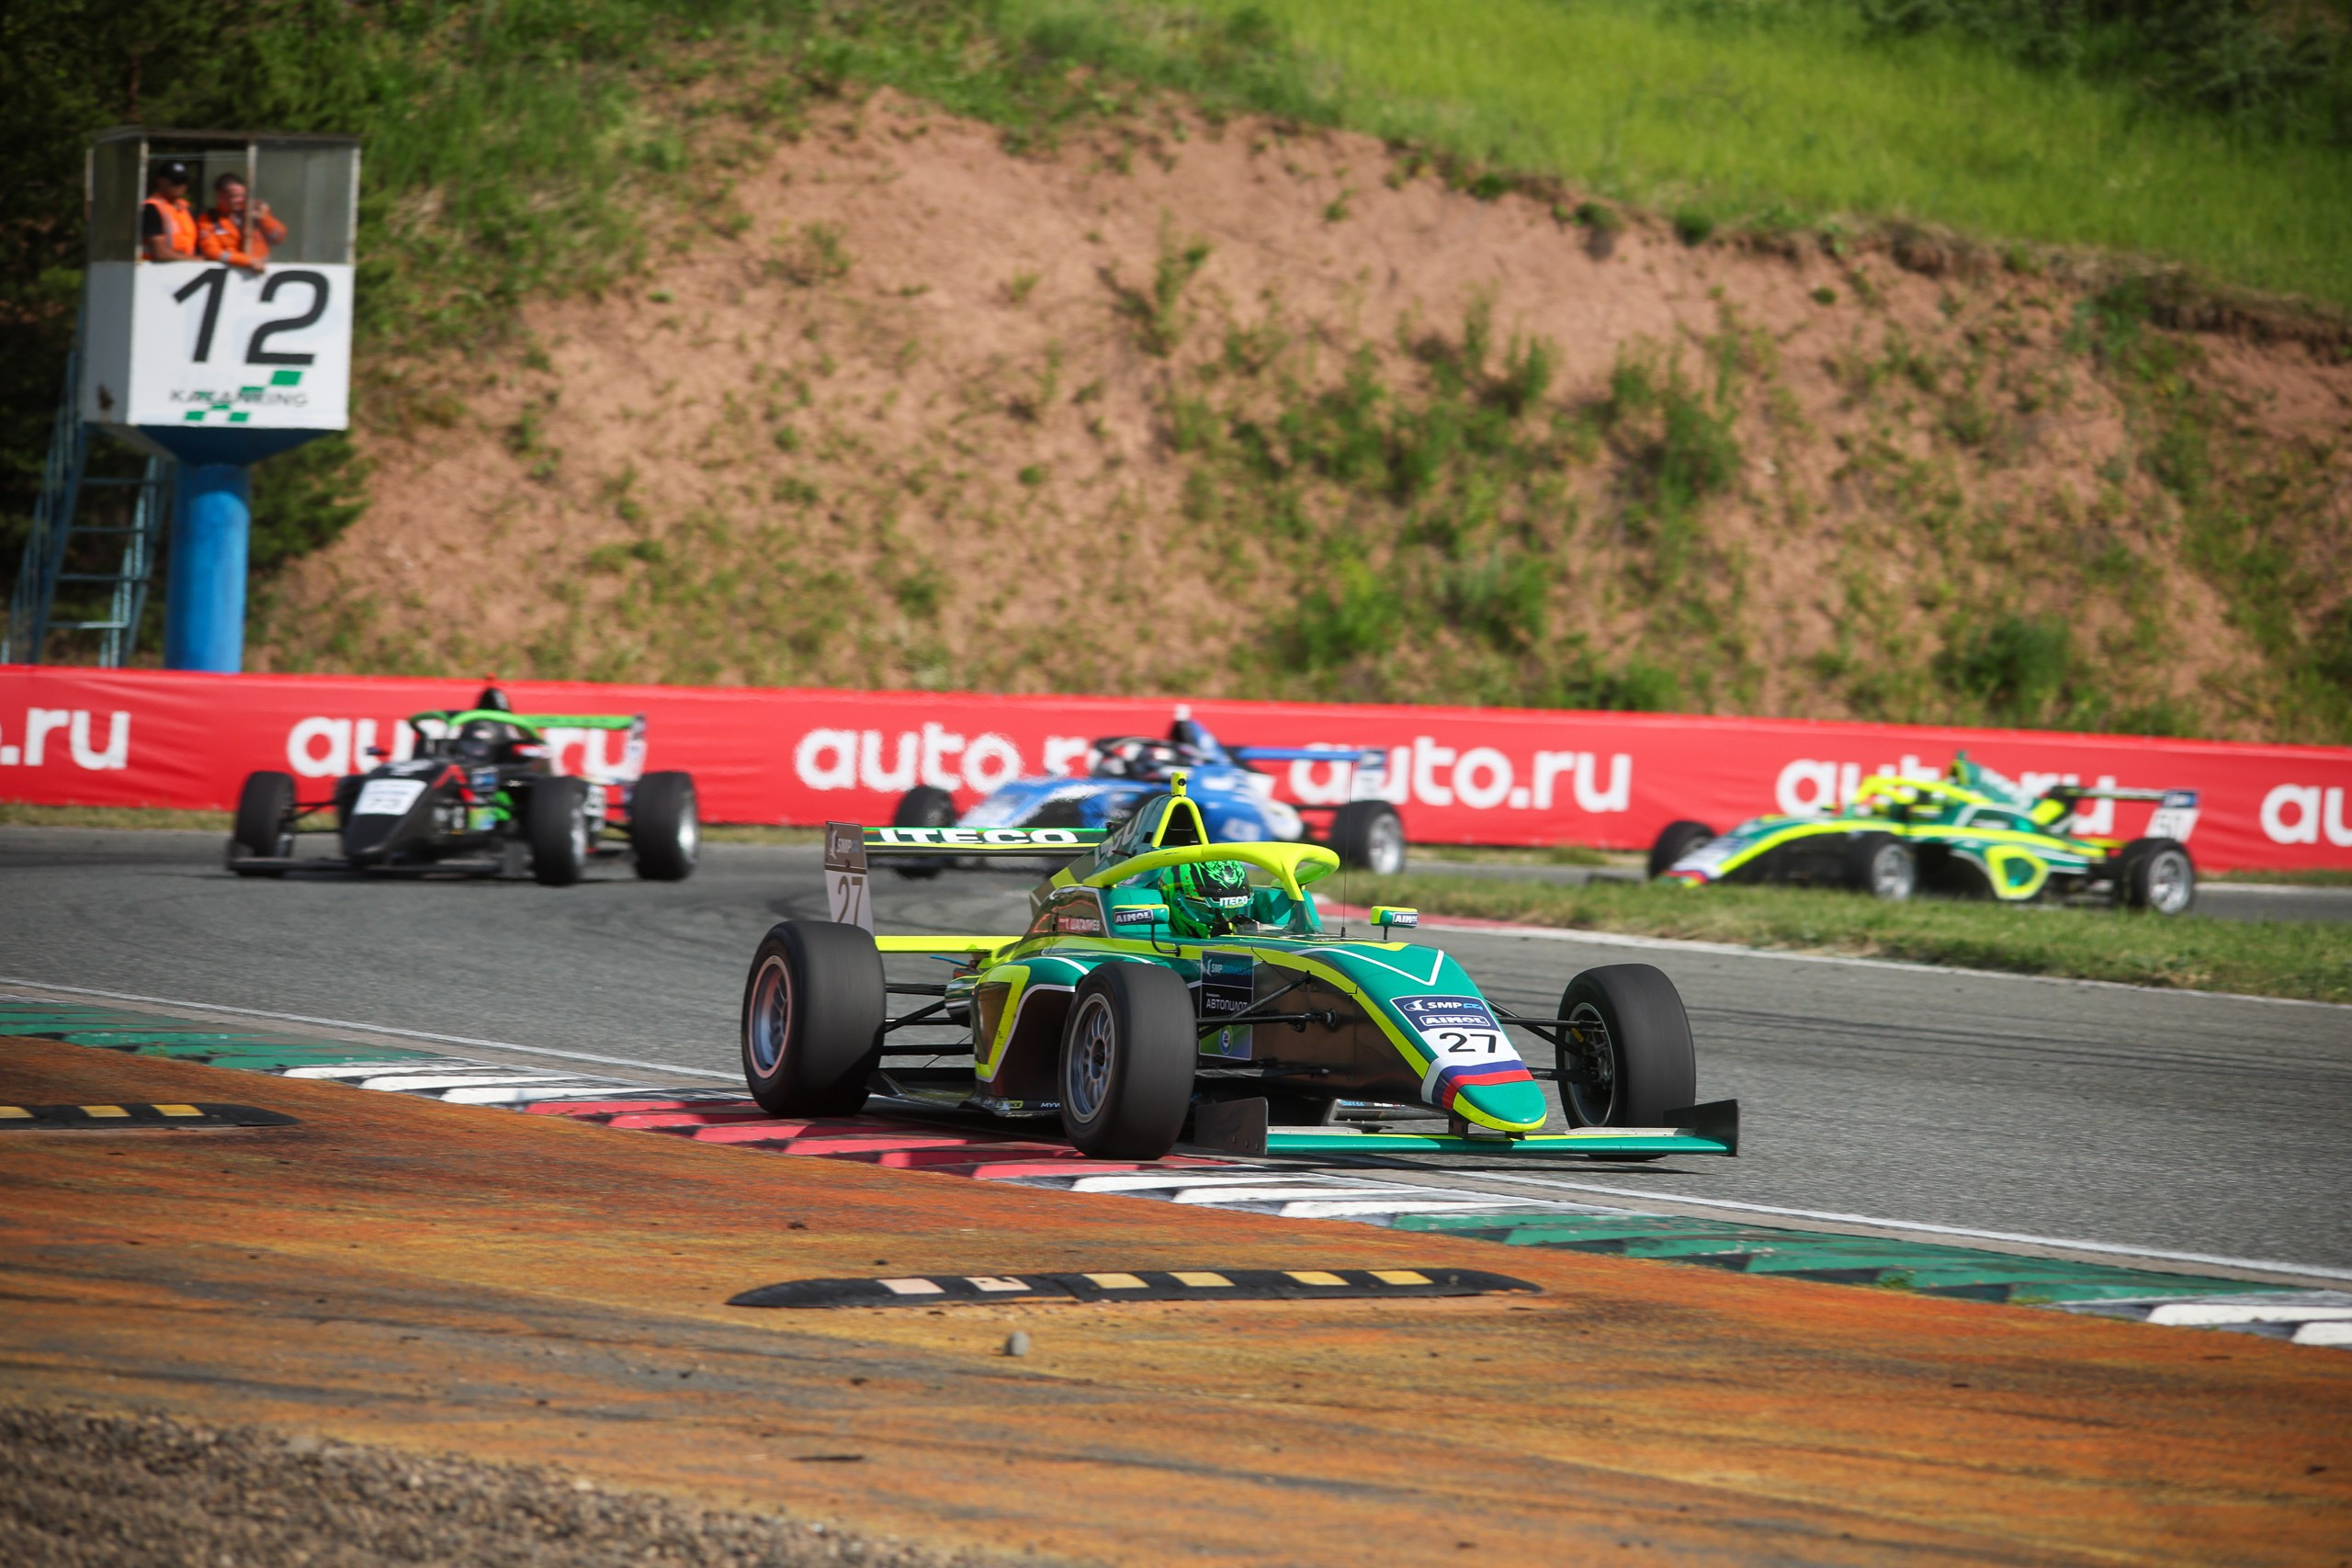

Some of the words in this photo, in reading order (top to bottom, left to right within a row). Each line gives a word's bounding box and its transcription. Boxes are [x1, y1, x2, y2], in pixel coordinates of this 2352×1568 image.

[172, 268, 331, 366] 12
[879, 829, 1079, 843] ITECO
[837, 875, 863, 926] 27
[1219, 896, 1248, 907] ITECO
[1115, 912, 1151, 923] AIMOL
[1427, 1001, 1462, 1010] SMP
[1439, 1032, 1497, 1054] 27
